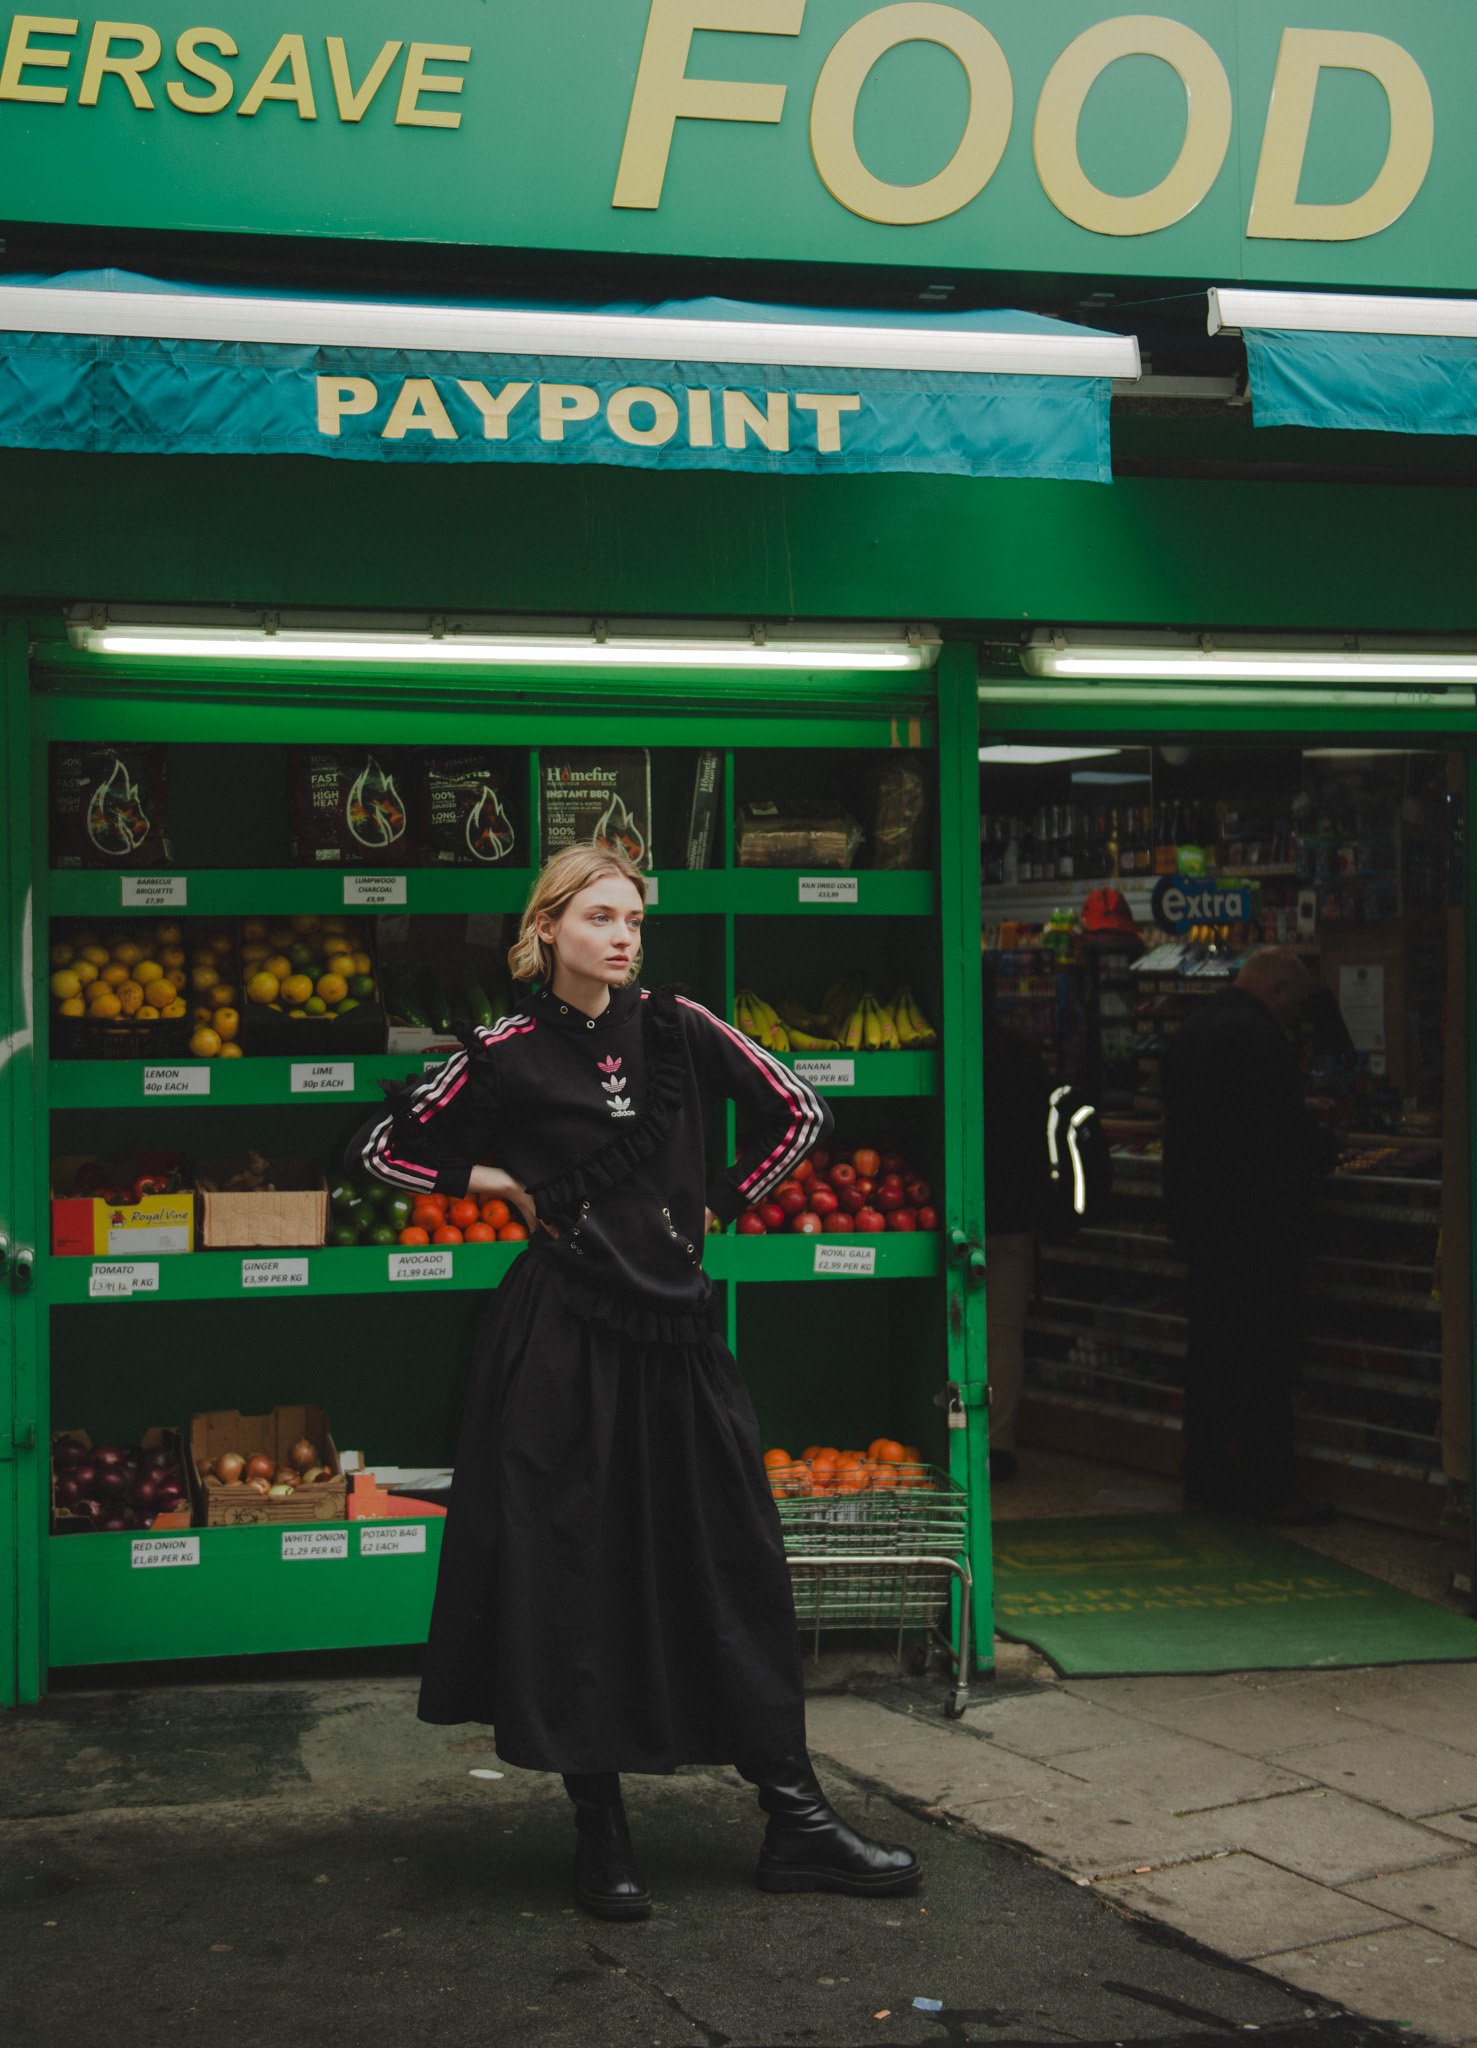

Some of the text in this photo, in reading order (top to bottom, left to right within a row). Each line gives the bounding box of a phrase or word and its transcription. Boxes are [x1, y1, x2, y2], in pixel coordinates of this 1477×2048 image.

[0, 15, 470, 128] ERSAVE
[613, 0, 1433, 240] FOOD
[316, 377, 861, 453] PAYPOINT
[311, 773, 338, 783] FAST
[546, 767, 617, 783] Homefire
[312, 790, 339, 800] HIGH
[546, 789, 610, 801] INSTANT BBQ
[312, 798, 339, 807] HEAT
[431, 811, 456, 820] LONG
[547, 827, 576, 835] 100%
[1162, 886, 1242, 922] extra
[145, 1070, 180, 1078] LEMON
[312, 1066, 335, 1075] LIME
[837, 1074, 849, 1082] KG
[145, 1082, 189, 1092] 40p EACH
[302, 1079, 344, 1089] 30p EACH
[611, 1109, 636, 1118] adidas
[131, 1208, 165, 1225] Royal
[165, 1209, 189, 1220] Vine
[820, 1248, 872, 1258] ROYAL GALA
[399, 1255, 444, 1265] AVOCADO
[94, 1265, 134, 1274] TOMATO
[244, 1261, 279, 1271] GINGER
[843, 1262, 859, 1270] PER
[860, 1263, 873, 1271] KG
[422, 1268, 447, 1276] EACH
[140, 1278, 154, 1287] KG
[270, 1273, 288, 1283] PER
[289, 1273, 303, 1282] KG
[284, 1532, 347, 1543] WHITE ONION
[362, 1528, 418, 1539] POTATO BAG
[133, 1540, 188, 1551] RED ONION
[310, 1546, 328, 1555] PER
[329, 1545, 342, 1554] KG
[362, 1542, 400, 1552] £2 EACH
[160, 1553, 179, 1563] PER
[180, 1553, 194, 1562] KG
